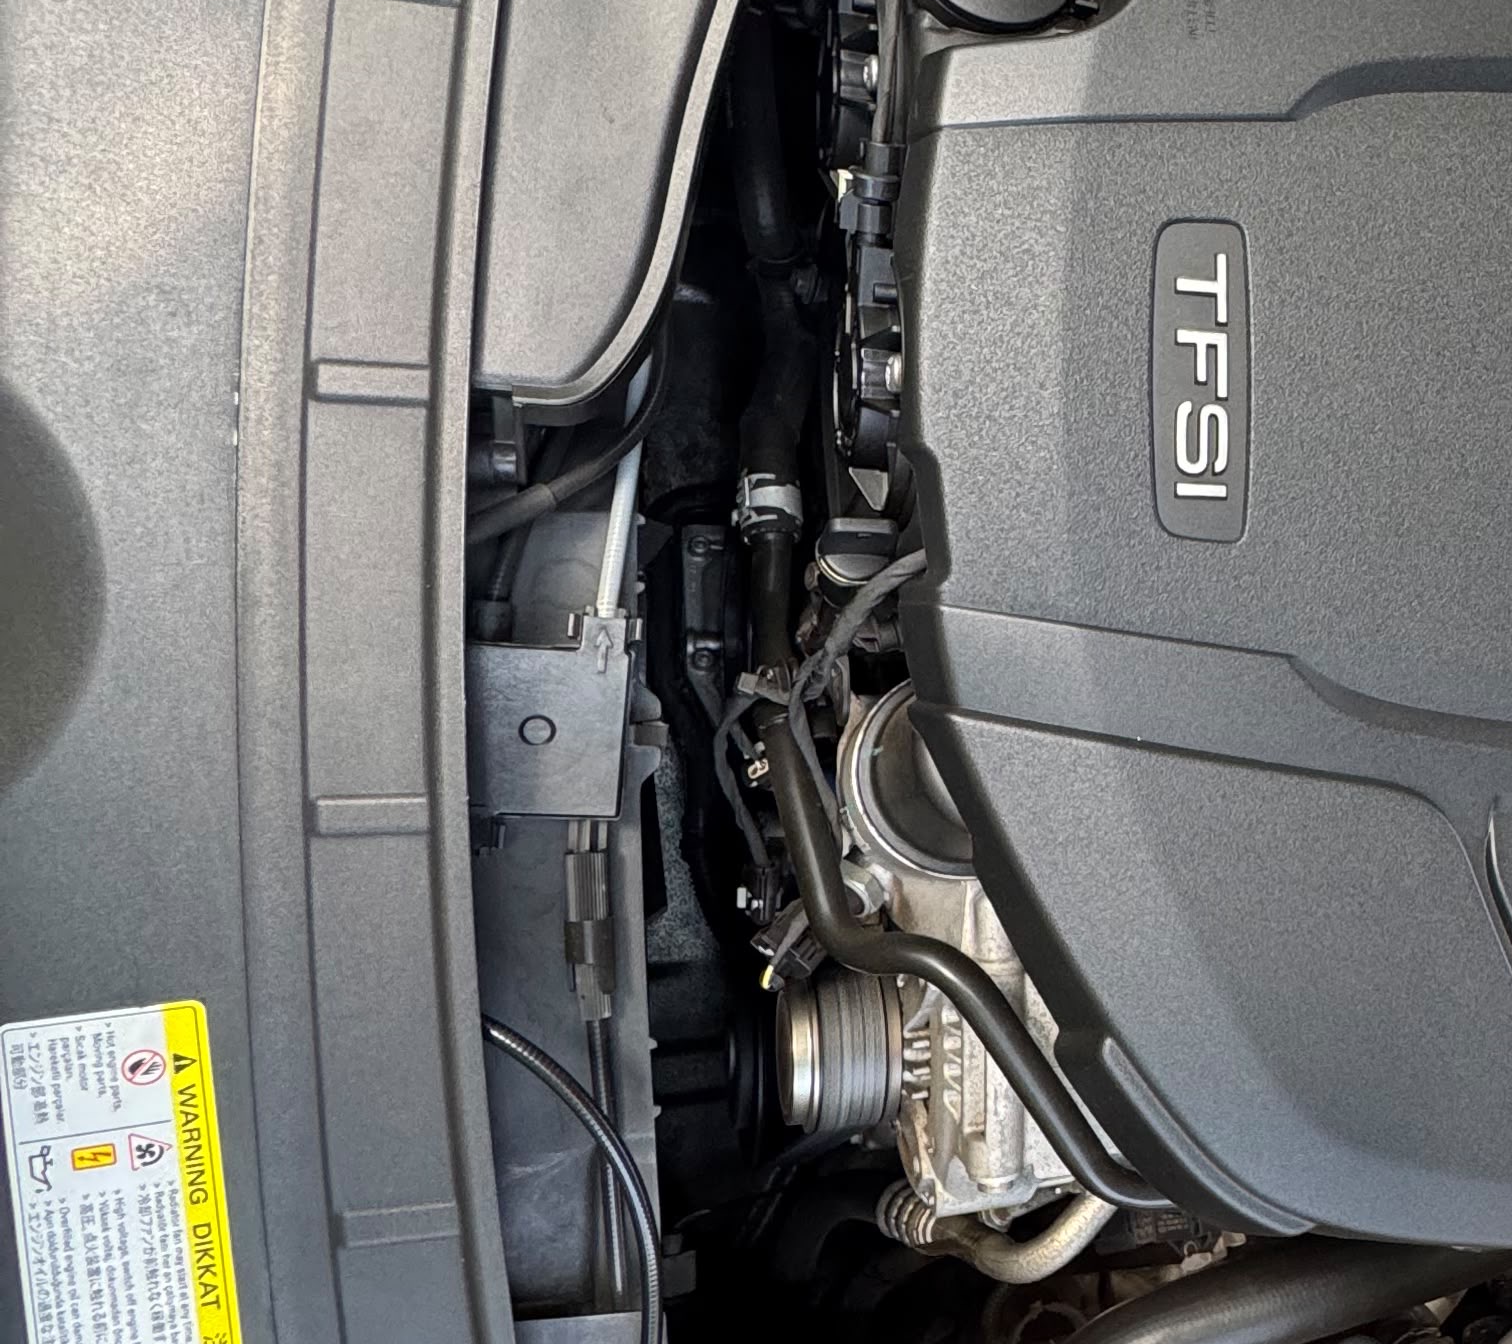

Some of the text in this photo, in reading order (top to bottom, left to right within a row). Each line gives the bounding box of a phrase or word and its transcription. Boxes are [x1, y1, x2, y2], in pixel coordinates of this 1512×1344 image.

[1174, 253, 1228, 501] TFSI
[88, 1033, 106, 1068] Moving
[76, 1063, 89, 1091] motor
[105, 1050, 118, 1082] engine
[175, 1083, 210, 1205] WARNING
[112, 1197, 126, 1220] High
[167, 1188, 183, 1226] Radiator
[58, 1206, 75, 1252] Overfilled
[172, 1228, 184, 1244] fan
[61, 1253, 78, 1287] engine
[172, 1246, 185, 1266] may
[191, 1222, 221, 1311] DIKKAT
[120, 1260, 135, 1291] switch
[176, 1267, 188, 1289] start
[68, 1287, 80, 1300] oil
[124, 1292, 136, 1306] off
[179, 1291, 189, 1301] at
[70, 1301, 81, 1319] can
[124, 1308, 139, 1340] engine
[178, 1303, 190, 1319] any
